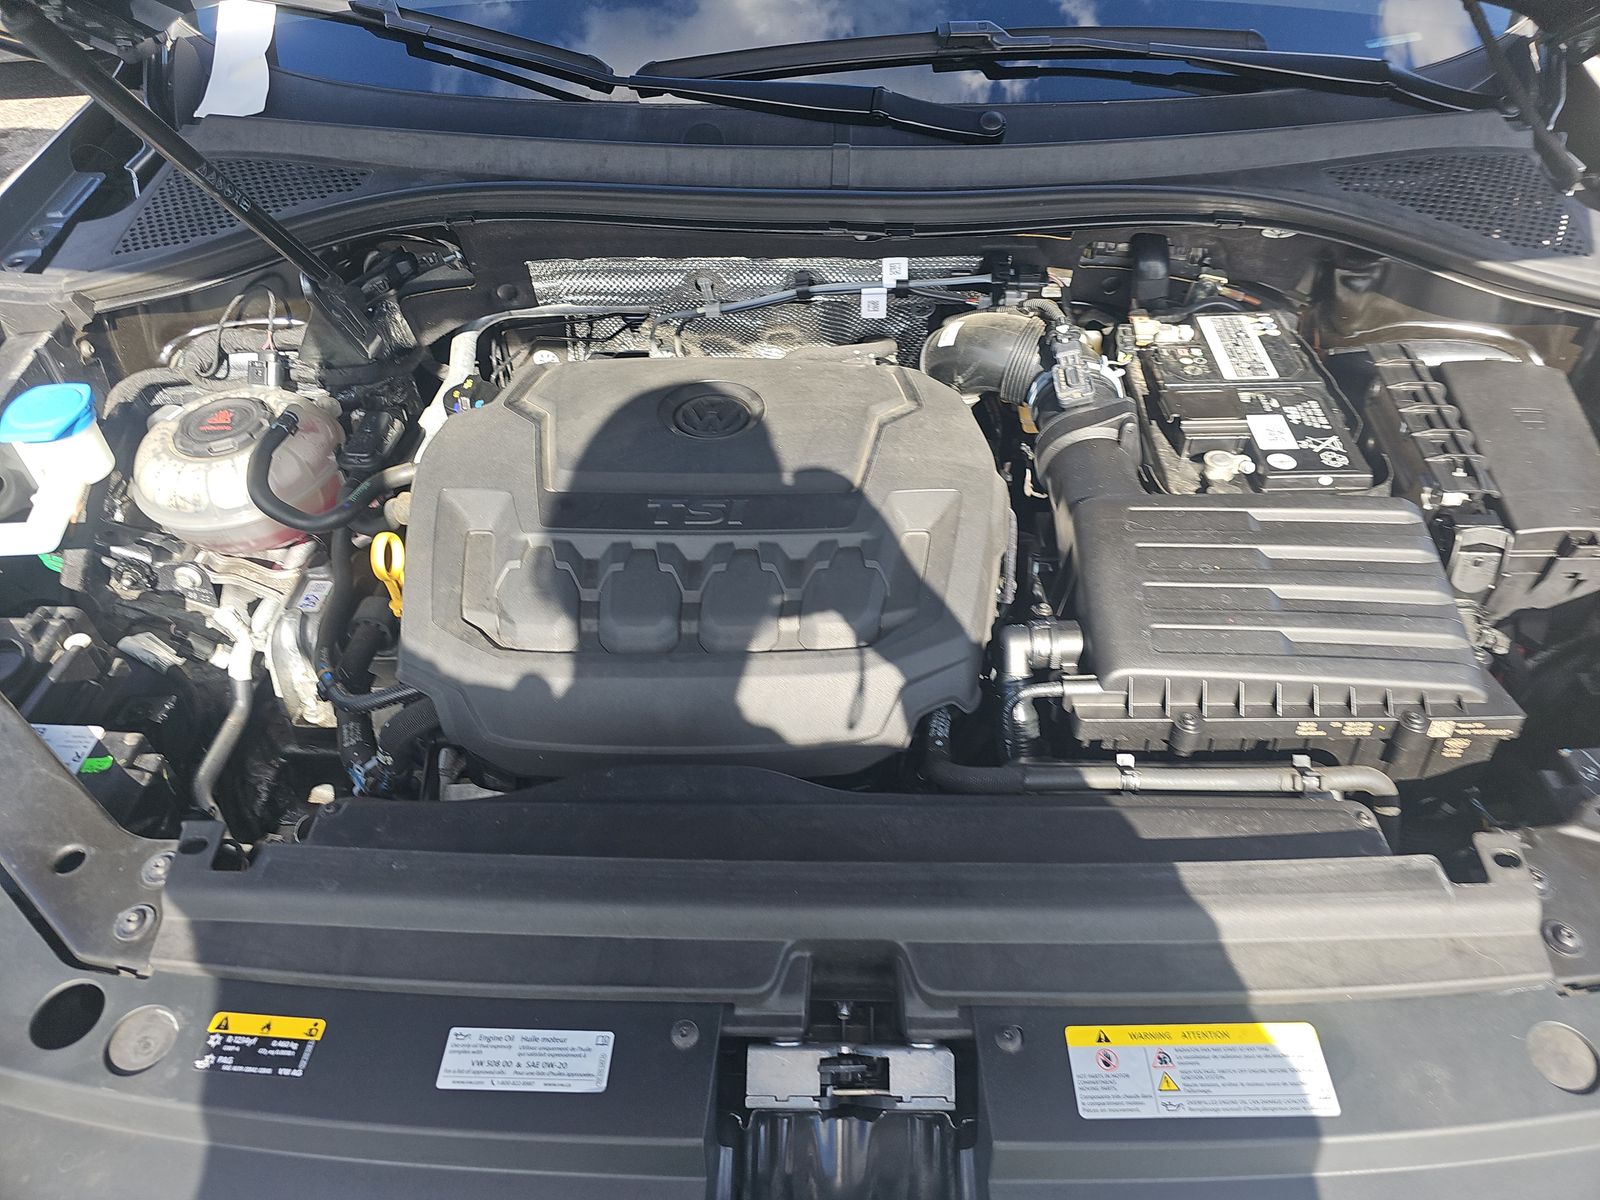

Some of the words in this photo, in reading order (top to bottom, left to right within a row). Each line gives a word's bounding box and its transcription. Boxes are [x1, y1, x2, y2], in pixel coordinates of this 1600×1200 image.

[647, 499, 747, 525] TSI
[479, 1033, 503, 1043] Engine
[504, 1034, 515, 1042] Oil
[1127, 1031, 1173, 1041] WARNING
[1181, 1030, 1231, 1040] ATTENTION
[471, 1059, 484, 1067] VW
[486, 1060, 501, 1068] 508
[502, 1060, 513, 1068] 00
[526, 1061, 540, 1069] SAE
